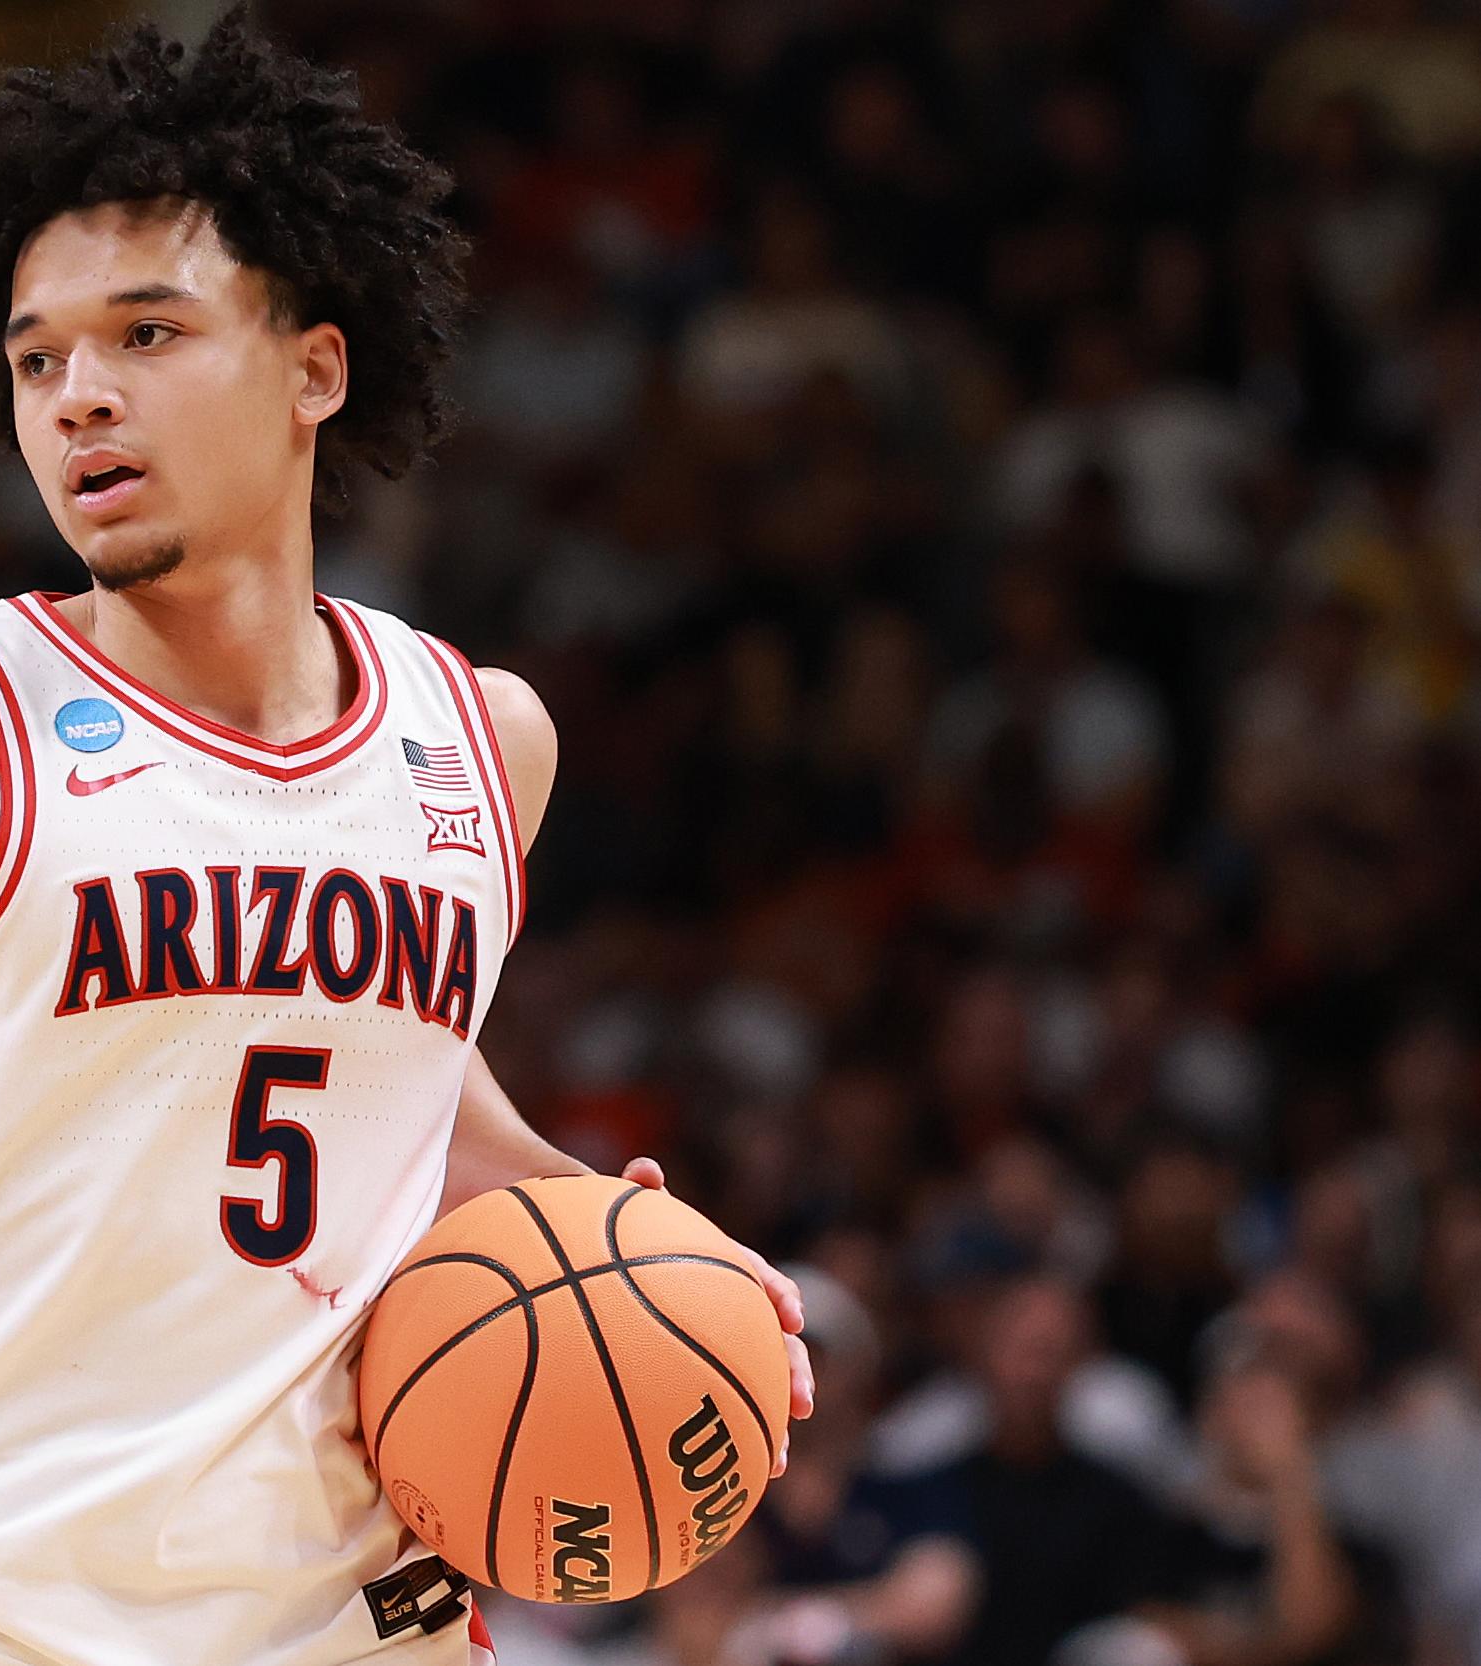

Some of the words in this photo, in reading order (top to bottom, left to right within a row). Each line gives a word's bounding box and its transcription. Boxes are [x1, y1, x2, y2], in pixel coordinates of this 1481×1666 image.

[65, 720, 121, 740] NCAA
[420, 802, 486, 858] XII
[54, 865, 477, 1041] ARIZONA
[220, 1045, 332, 1267] 5
[534, 1496, 544, 1561] OFFICIAL
[550, 1496, 612, 1603] NCA
